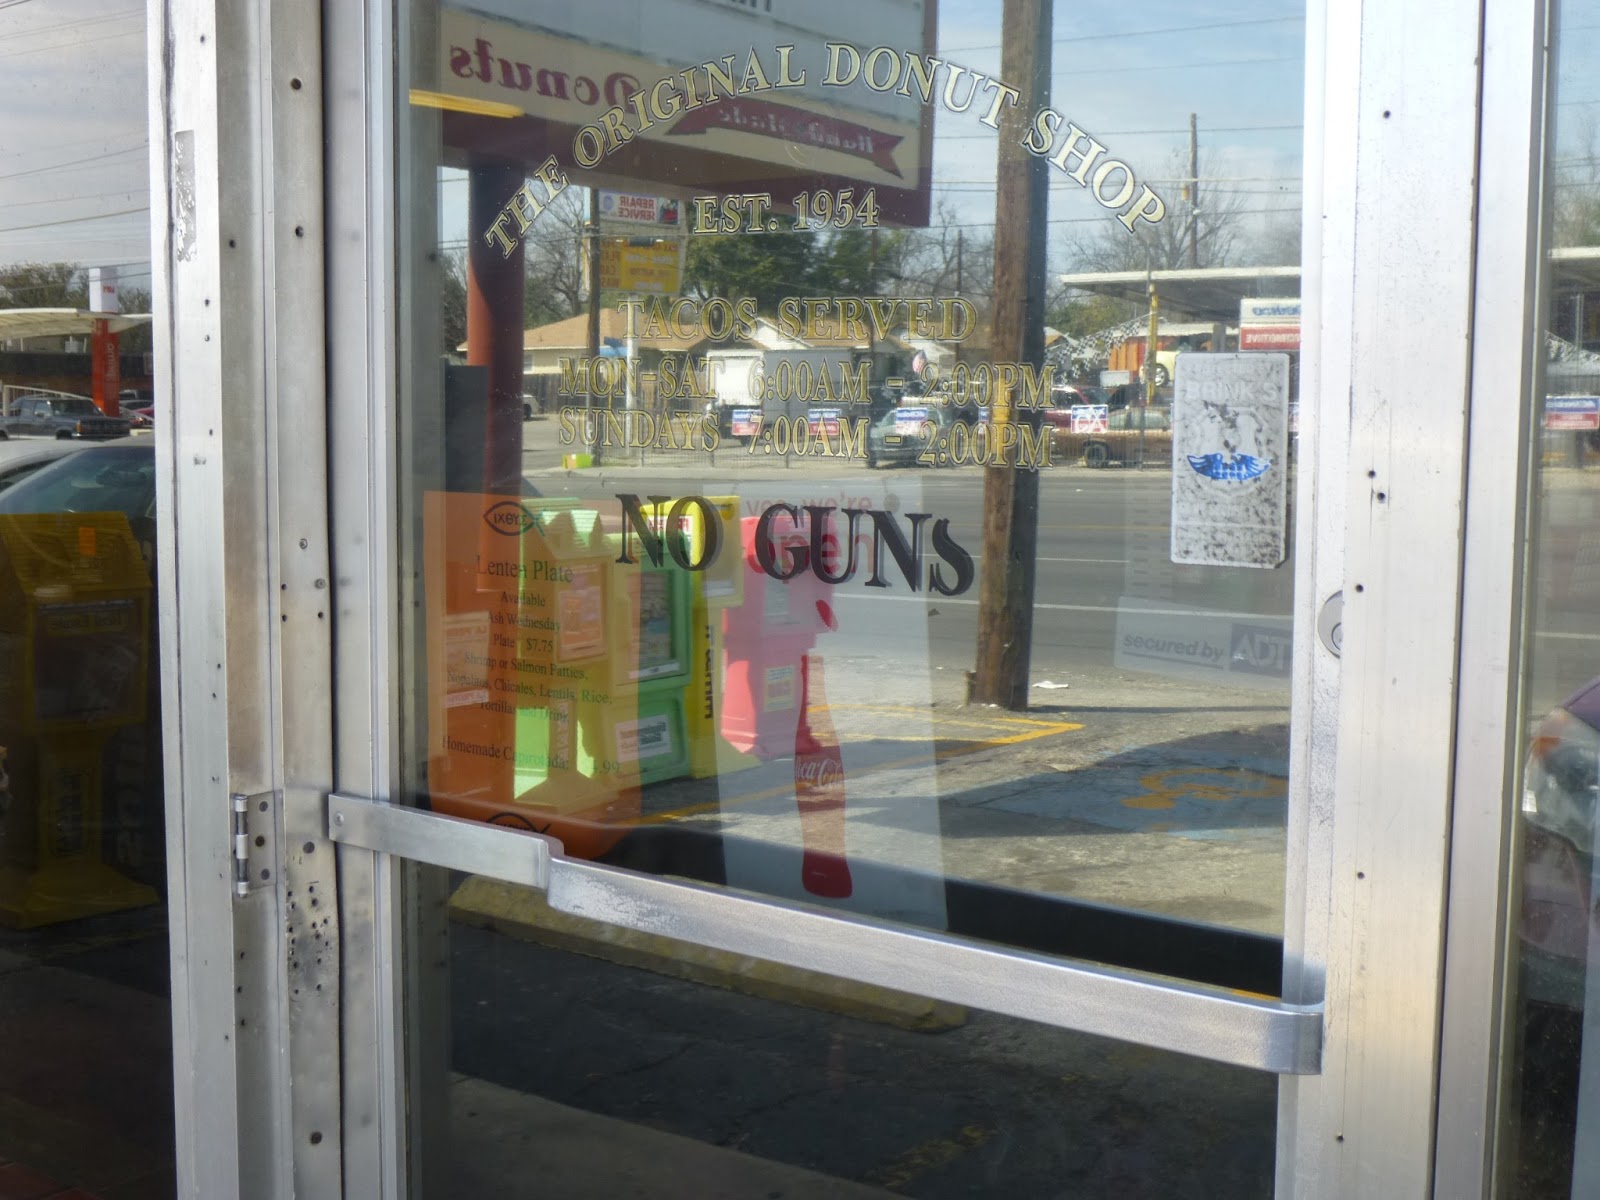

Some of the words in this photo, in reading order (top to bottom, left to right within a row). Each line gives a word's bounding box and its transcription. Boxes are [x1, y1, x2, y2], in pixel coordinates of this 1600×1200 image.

[485, 155, 570, 258] THE
[573, 45, 806, 168] ORIGINAL
[822, 42, 1020, 129] DONUT
[1022, 106, 1166, 234] SHOP
[694, 194, 779, 235] EST.
[792, 188, 880, 231] 1954
[617, 296, 758, 342] TACOS
[778, 296, 977, 342] SERVED
[558, 353, 725, 399] MON-SAT
[747, 356, 872, 406] 6:00AM
[920, 362, 1057, 413] 2:00PM
[558, 406, 720, 452] SUNDAYS
[748, 413, 871, 462] 7:00AM
[917, 419, 1054, 472] 2:00PM
[615, 493, 723, 572] NO
[754, 502, 975, 597] GUNS
[476, 555, 527, 580] Lenten
[533, 560, 574, 584] Plate
[501, 591, 546, 606] Available
[488, 611, 504, 624] Ash
[507, 612, 560, 632] Wednesday
[494, 634, 515, 648] Plate
[526, 638, 553, 654] $7.75
[1124, 633, 1200, 657] secured
[1202, 640, 1224, 664] by
[1232, 633, 1290, 670] ADT
[464, 651, 497, 670] Shrimp
[499, 659, 509, 669] or
[510, 658, 547, 675] Salmon
[480, 697, 517, 715] Tortillas
[443, 736, 501, 759] Homemade
